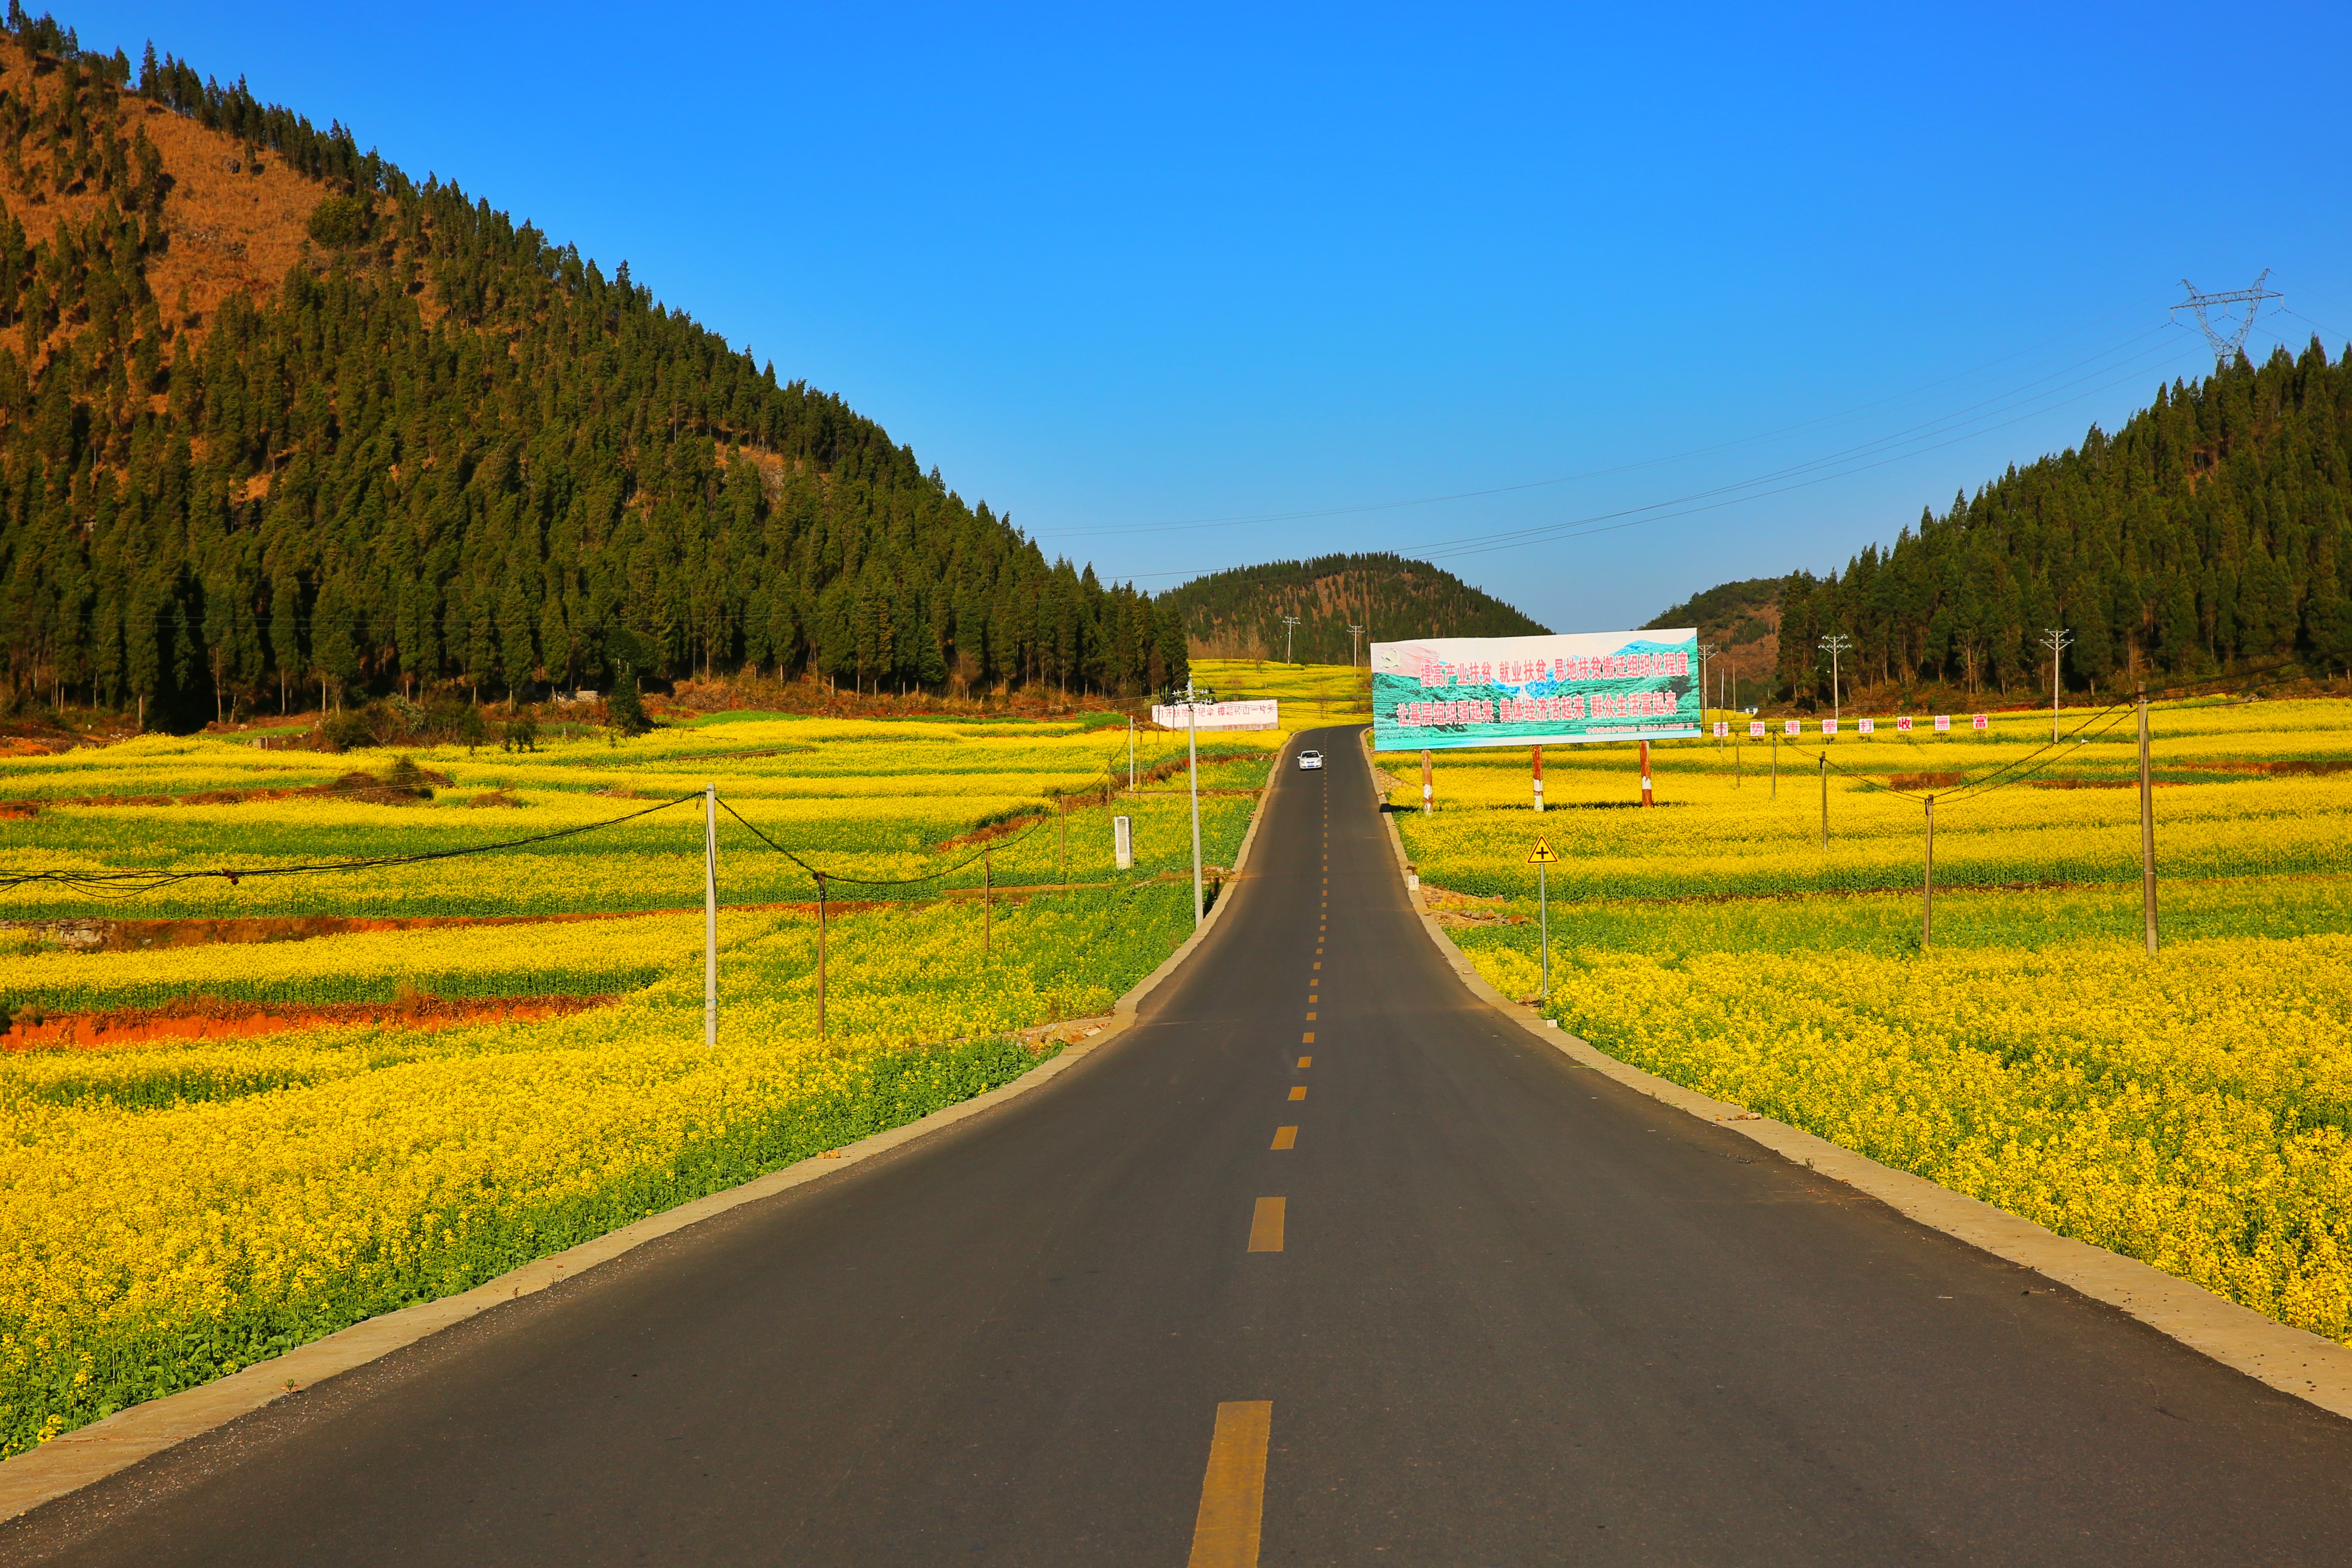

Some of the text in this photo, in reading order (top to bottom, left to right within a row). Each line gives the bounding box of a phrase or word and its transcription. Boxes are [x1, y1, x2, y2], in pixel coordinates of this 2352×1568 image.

[1420, 651, 1688, 687] 提高产业扶贫 就业扶贫 易地扶贫搬迁组织化程度
[1397, 690, 1677, 726] 让基层组织强起来 集体经济活起来 群众生活富起来
[1824, 720, 1835, 733] 拳
[1861, 720, 1873, 732] 打
[1899, 718, 1911, 729] 收
[1936, 717, 1949, 729] 黑
[1974, 716, 1986, 728] 富
[1752, 722, 1763, 735] 势
